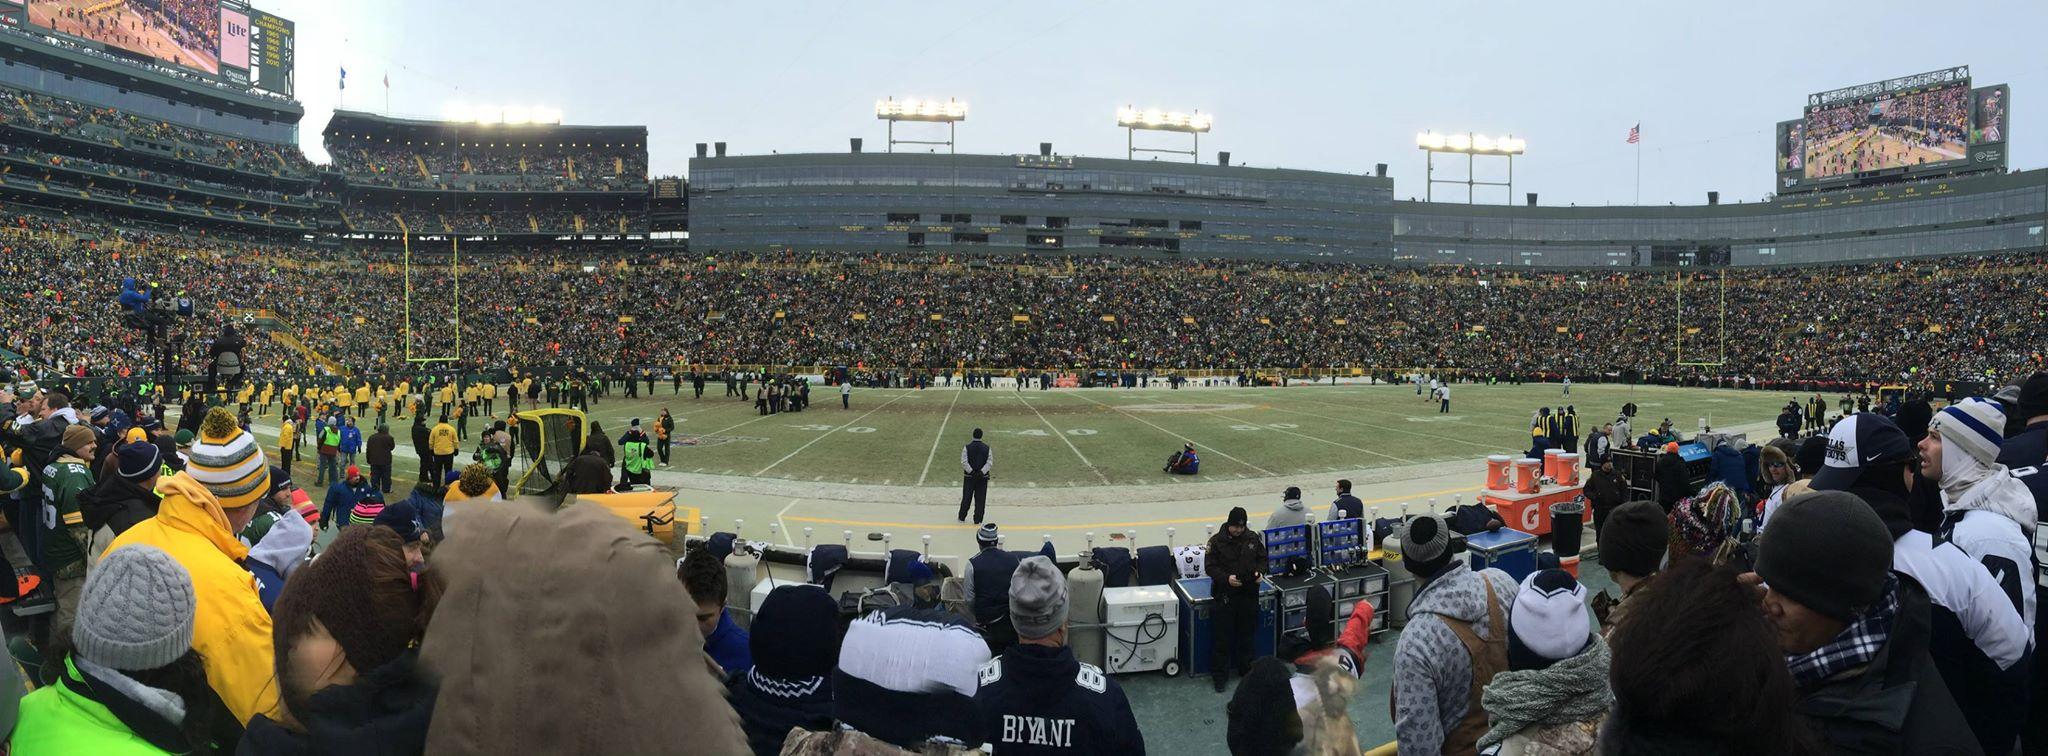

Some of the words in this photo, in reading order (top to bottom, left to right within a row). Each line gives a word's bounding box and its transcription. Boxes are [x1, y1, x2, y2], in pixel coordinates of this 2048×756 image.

[255, 19, 290, 35] CHAMPIONS
[261, 15, 284, 26] WORLD
[227, 21, 248, 37] Lite
[225, 69, 248, 82] ONEIDA
[1823, 80, 1893, 102] LAMBEAU
[1900, 70, 1946, 88] FIELD
[67, 463, 86, 474] 56
[1521, 502, 1540, 531] G
